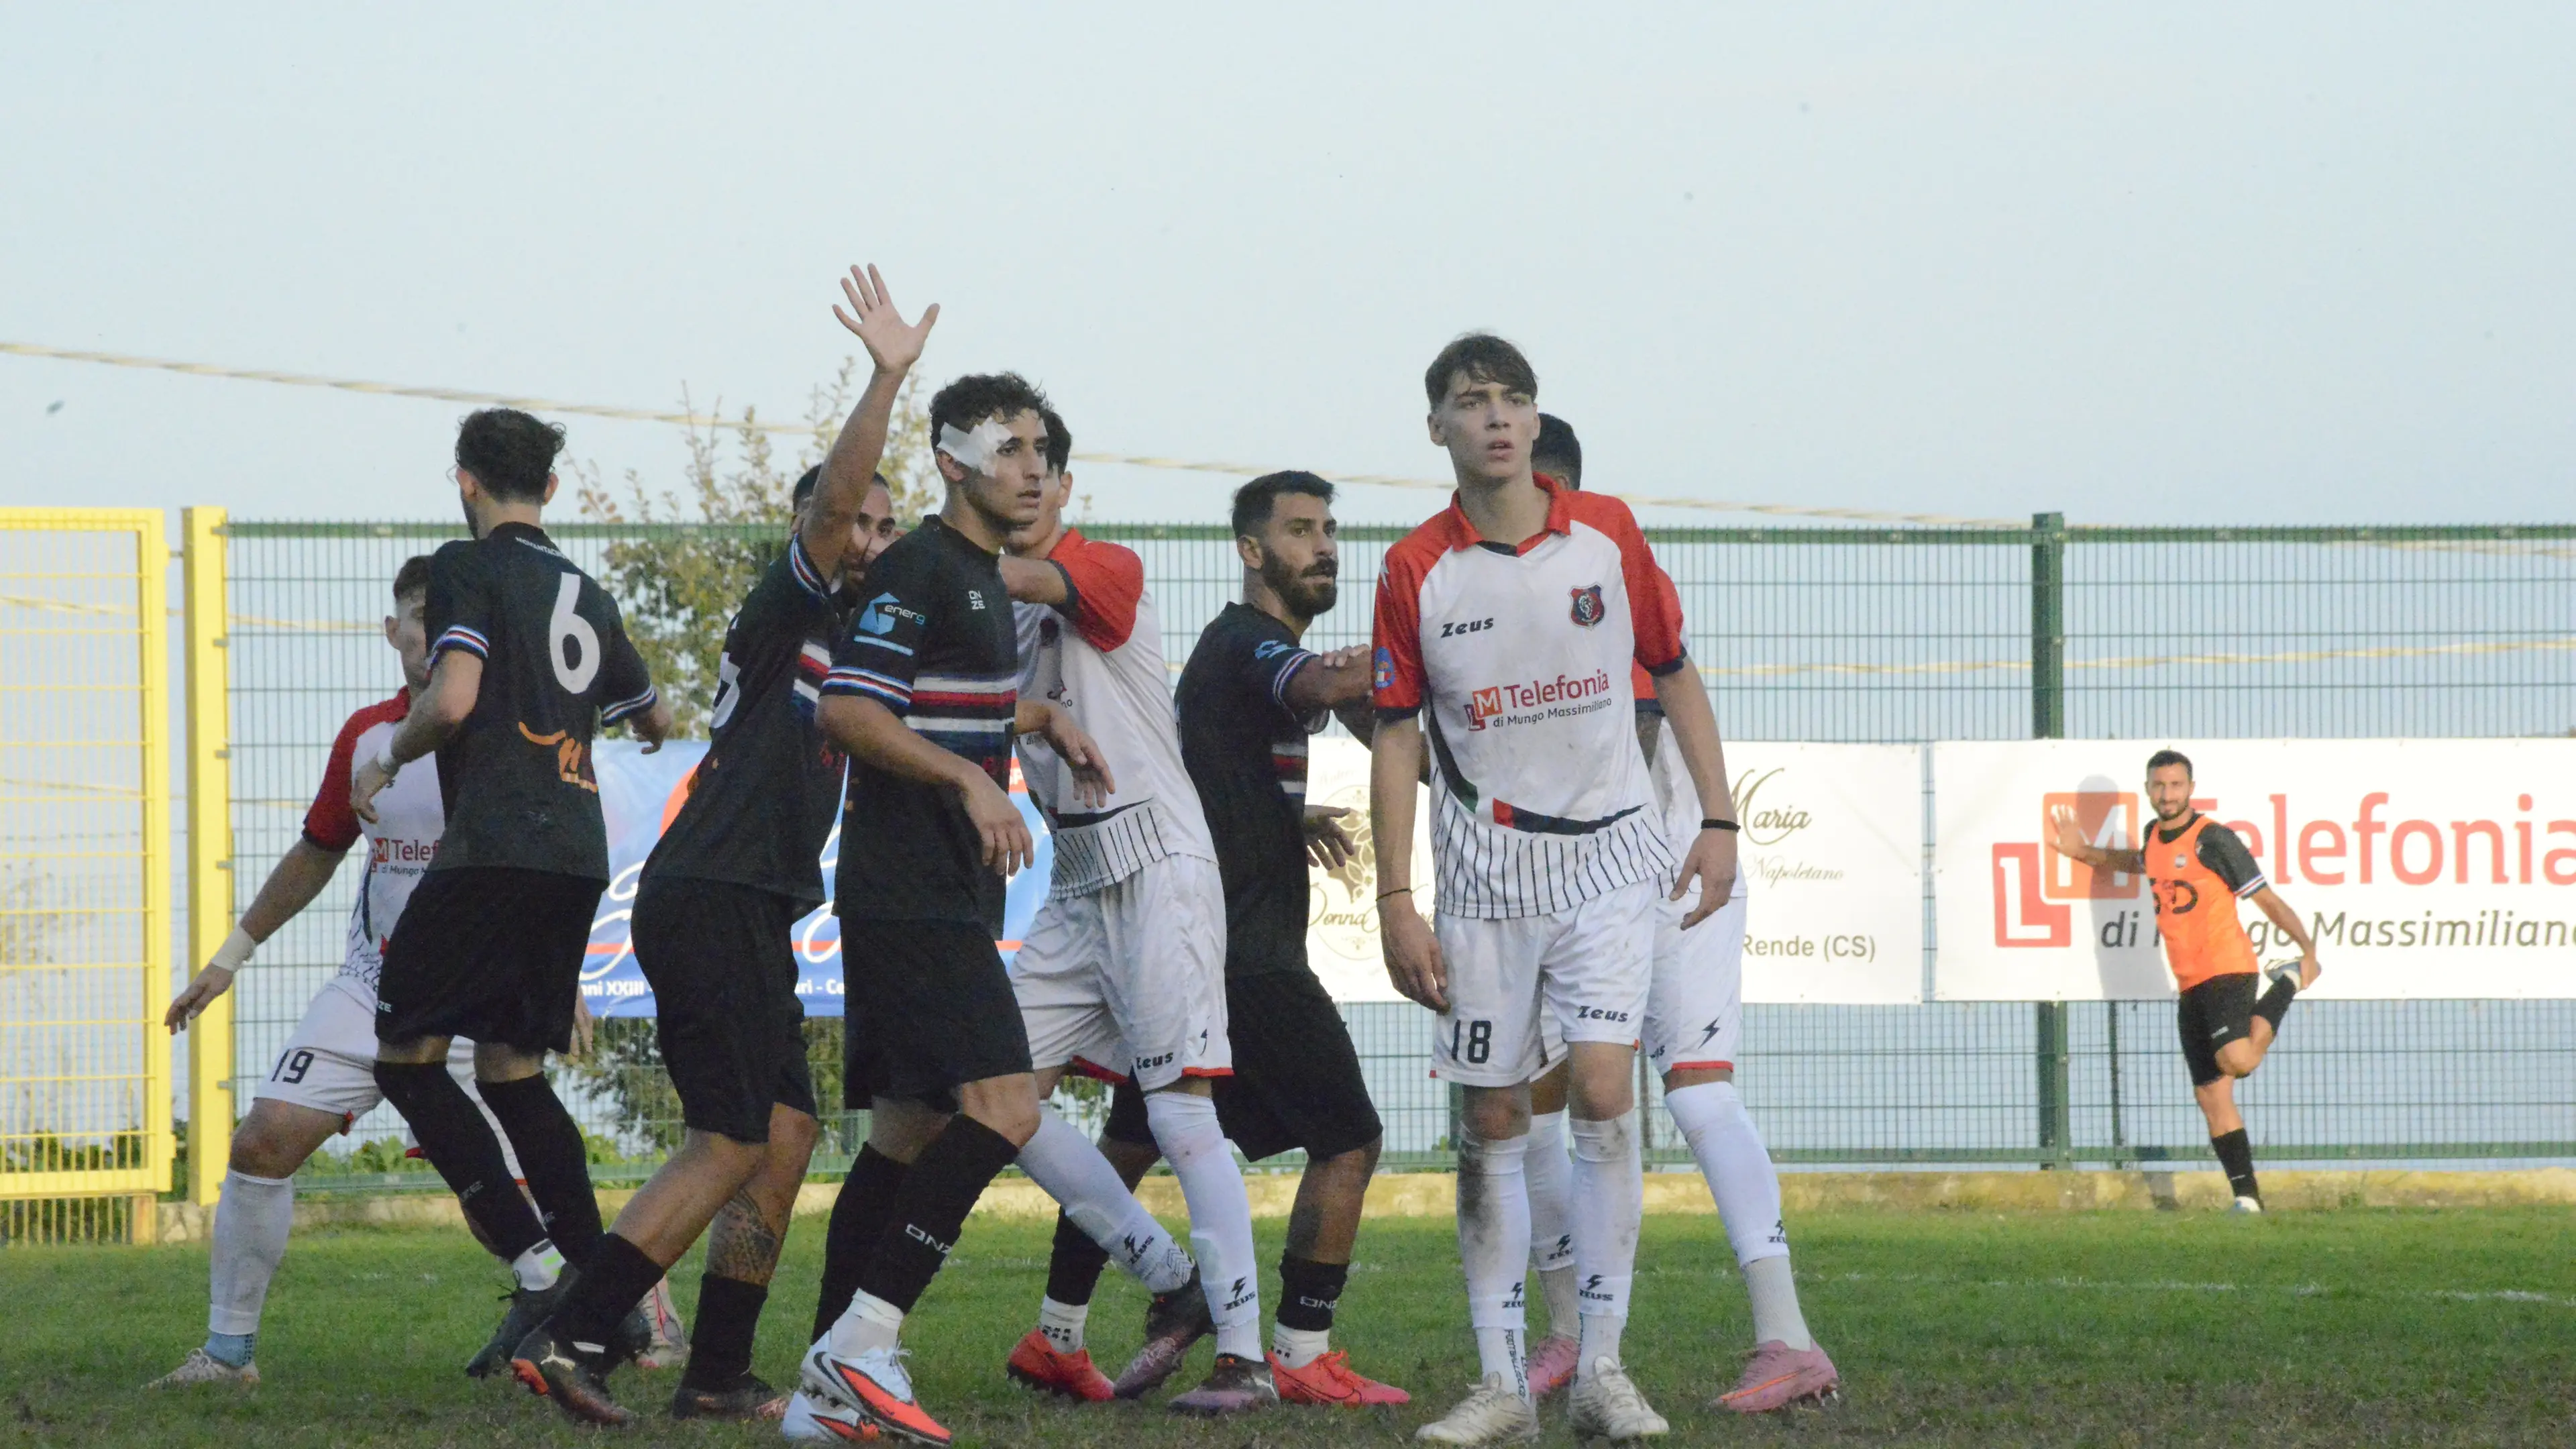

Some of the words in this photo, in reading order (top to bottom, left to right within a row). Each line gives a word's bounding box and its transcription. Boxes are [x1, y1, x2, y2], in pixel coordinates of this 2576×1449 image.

[549, 572, 601, 694] 6
[1440, 617, 1495, 638] Zeus
[1503, 668, 1609, 708] Telefonia
[1493, 716, 1504, 727] di
[1507, 712, 1544, 727] Mungo
[1547, 698, 1612, 718] Massimiliano
[1731, 767, 1812, 846] Maria
[1744, 853, 1845, 890] Napoletano
[2100, 910, 2140, 948] di
[2313, 909, 2576, 948] Massimilian
[1744, 934, 1815, 957] Rende
[1823, 934, 1876, 963] (CS)
[606, 980, 644, 996] XXIII
[1577, 1006, 1629, 1023] Zeus
[1450, 1019, 1493, 1065] 18
[270, 1048, 315, 1084] 19
